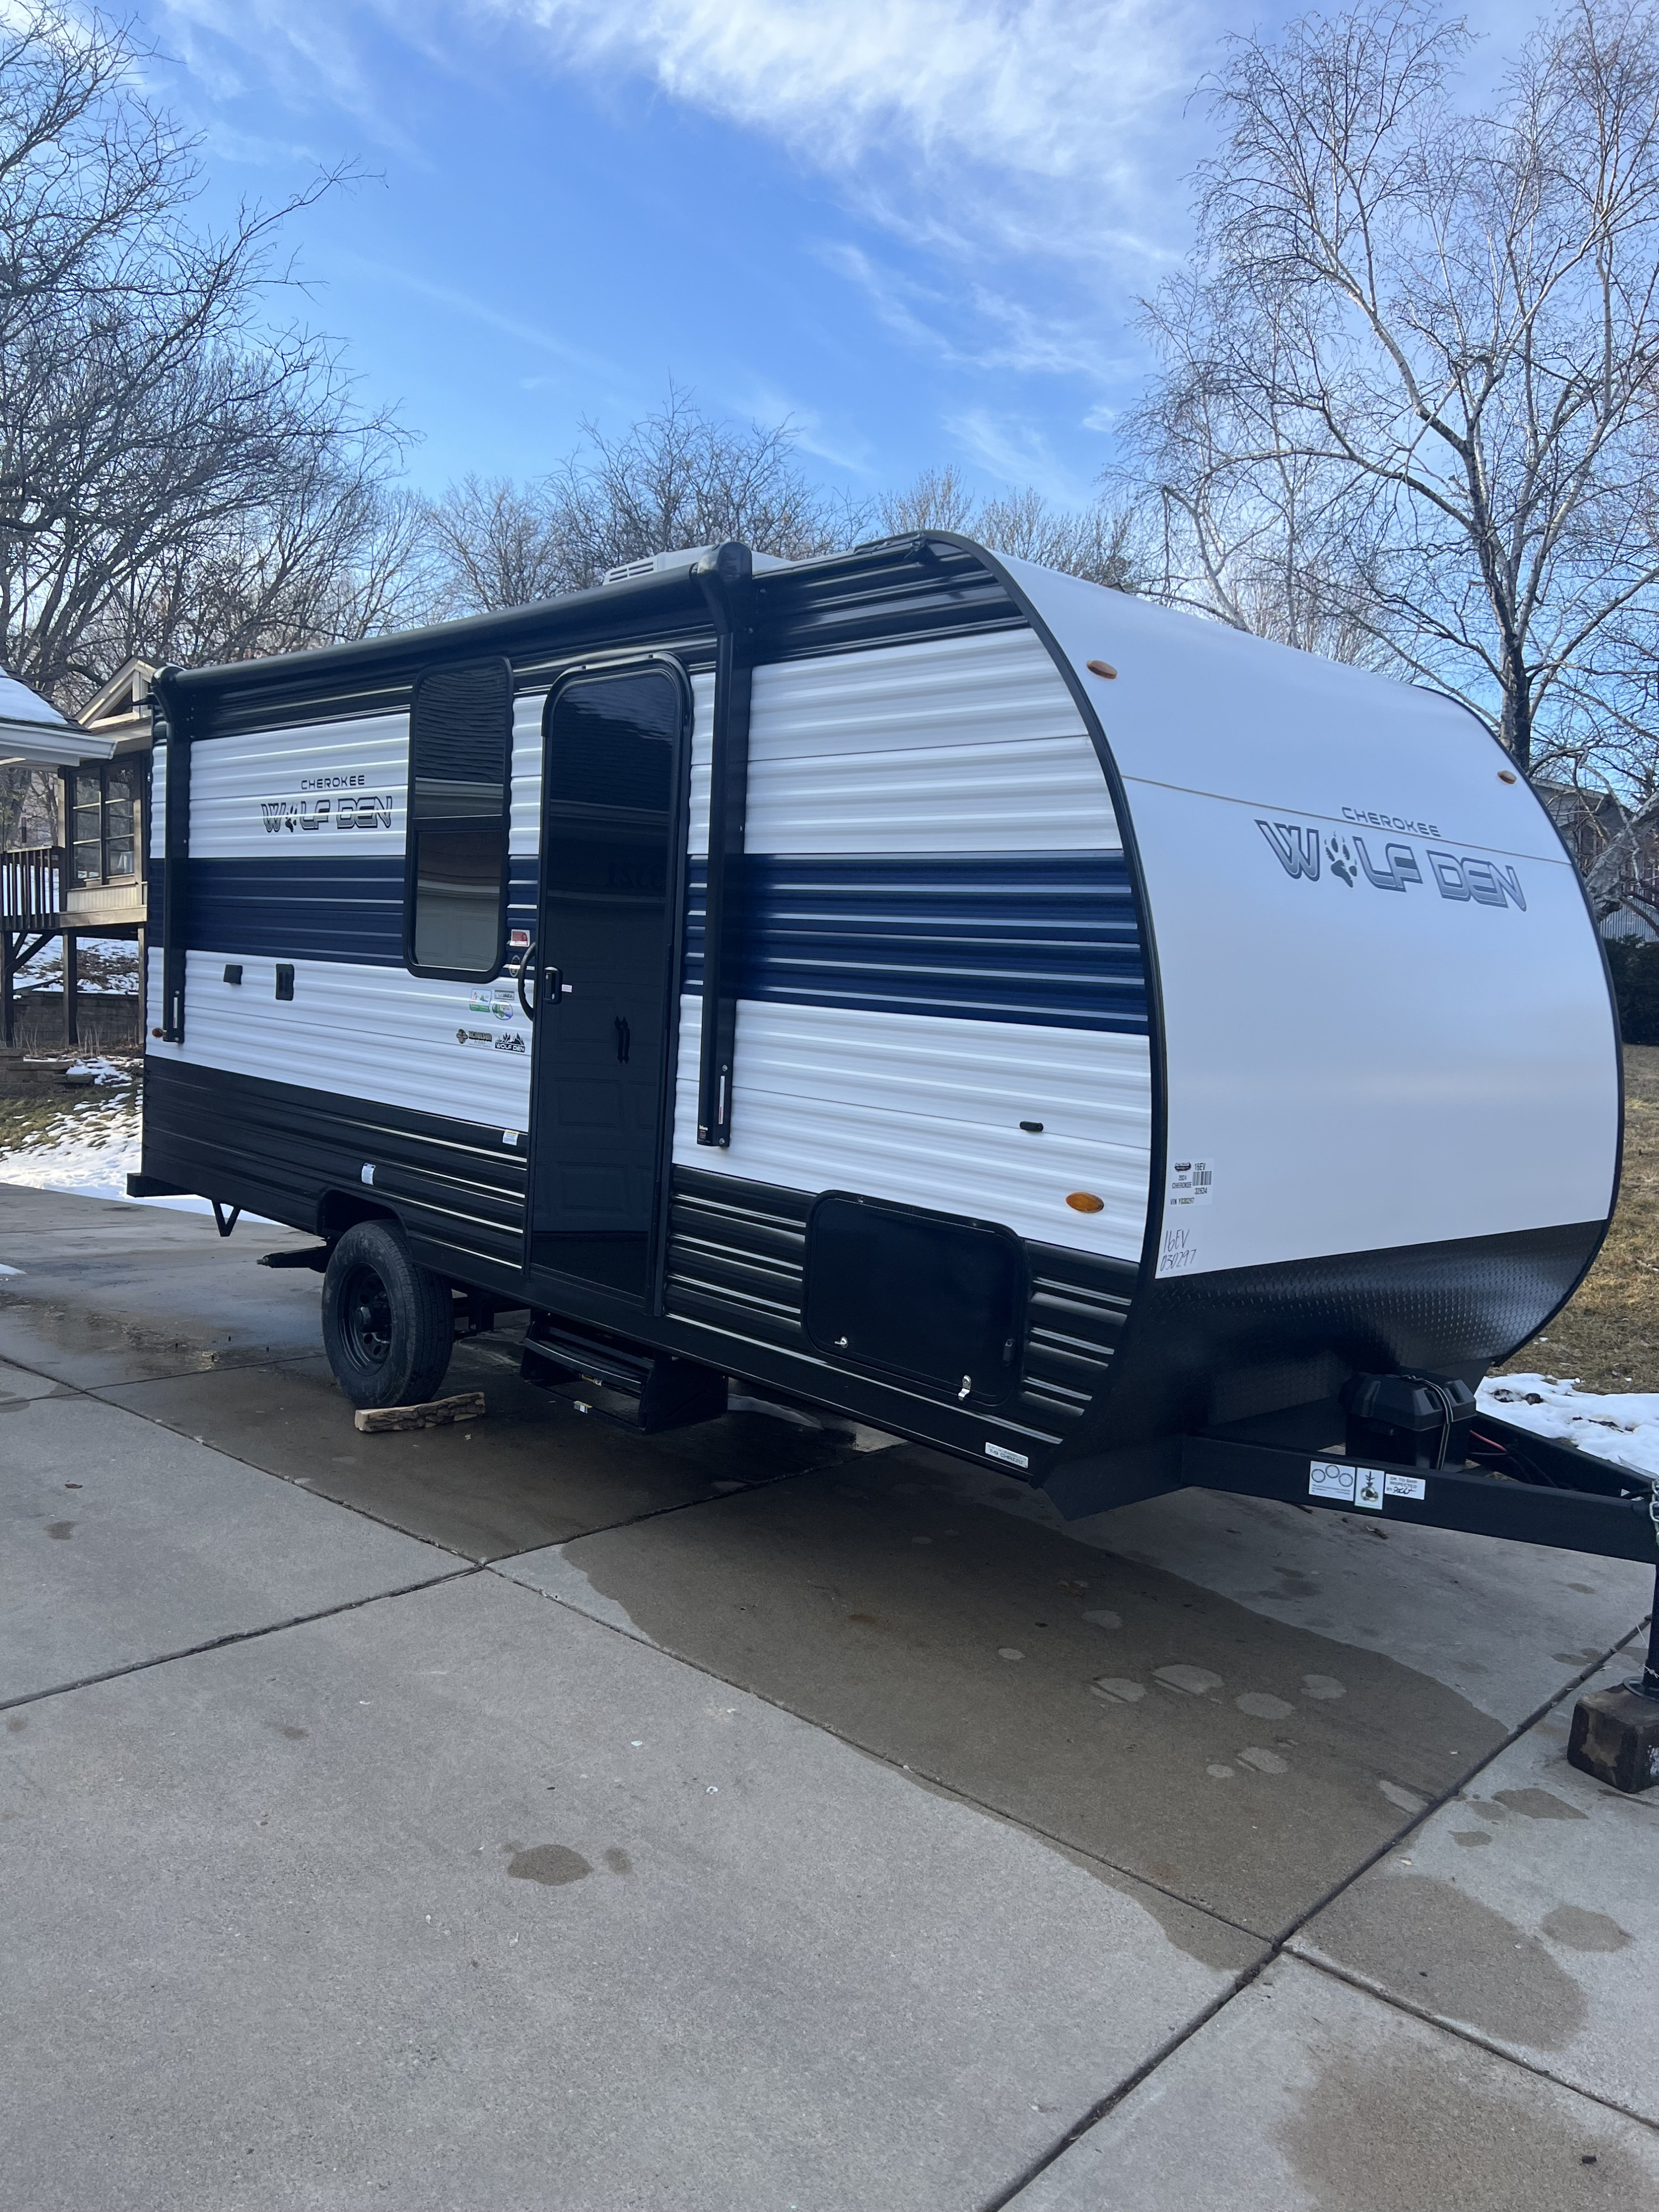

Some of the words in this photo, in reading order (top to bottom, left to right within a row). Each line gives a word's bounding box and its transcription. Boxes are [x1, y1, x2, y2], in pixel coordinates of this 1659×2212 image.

[301, 775, 365, 790] CHEROKEE
[336, 796, 393, 830] DEN
[1342, 806, 1441, 838] CHEROKEE
[1425, 849, 1527, 912] DEN
[1164, 1228, 1190, 1253] 16EV
[1160, 1248, 1197, 1271] 030297
